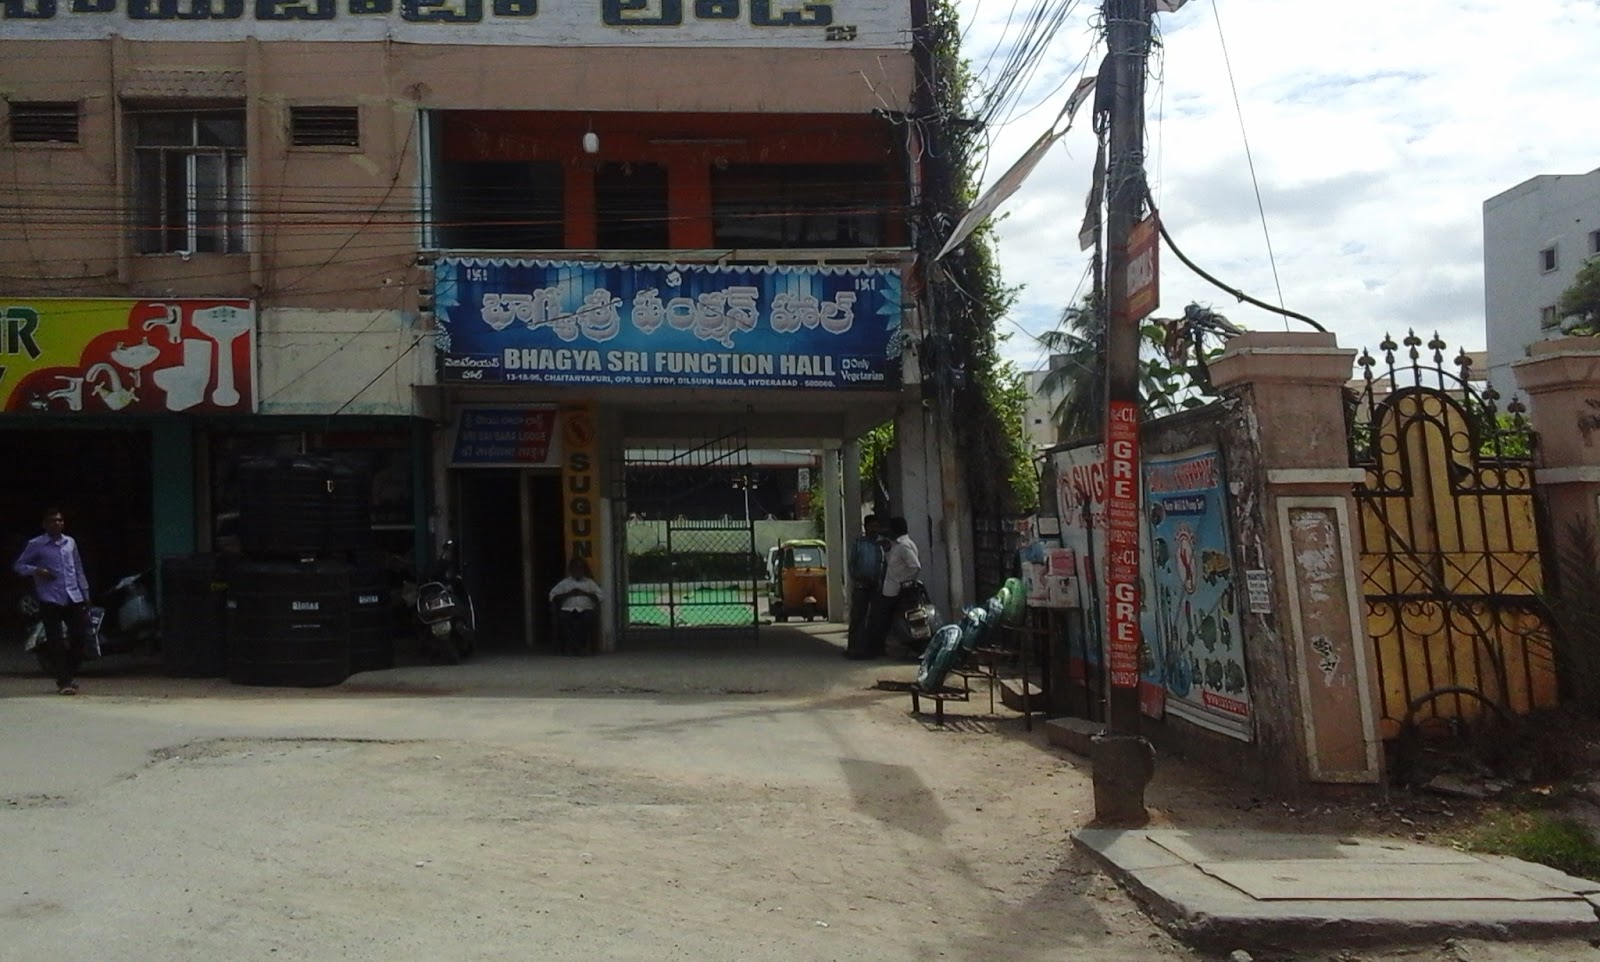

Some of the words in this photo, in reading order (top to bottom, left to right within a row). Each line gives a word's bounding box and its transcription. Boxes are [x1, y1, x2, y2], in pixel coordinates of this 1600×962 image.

[770, 291, 857, 334] హాల్
[0, 307, 41, 361] R
[504, 348, 600, 371] BHAGYA
[607, 351, 648, 372] SRI
[655, 351, 773, 374] FUNCTION
[780, 355, 836, 375] HALL
[851, 359, 869, 370] Only
[634, 375, 652, 384] BUS
[653, 376, 676, 385] STOP,
[677, 377, 714, 385] DILSUKH
[716, 378, 747, 387] NAGAR,
[748, 379, 798, 387] HYDERABAD
[841, 370, 884, 382] Vegetarian
[569, 453, 593, 558] SUGUN
